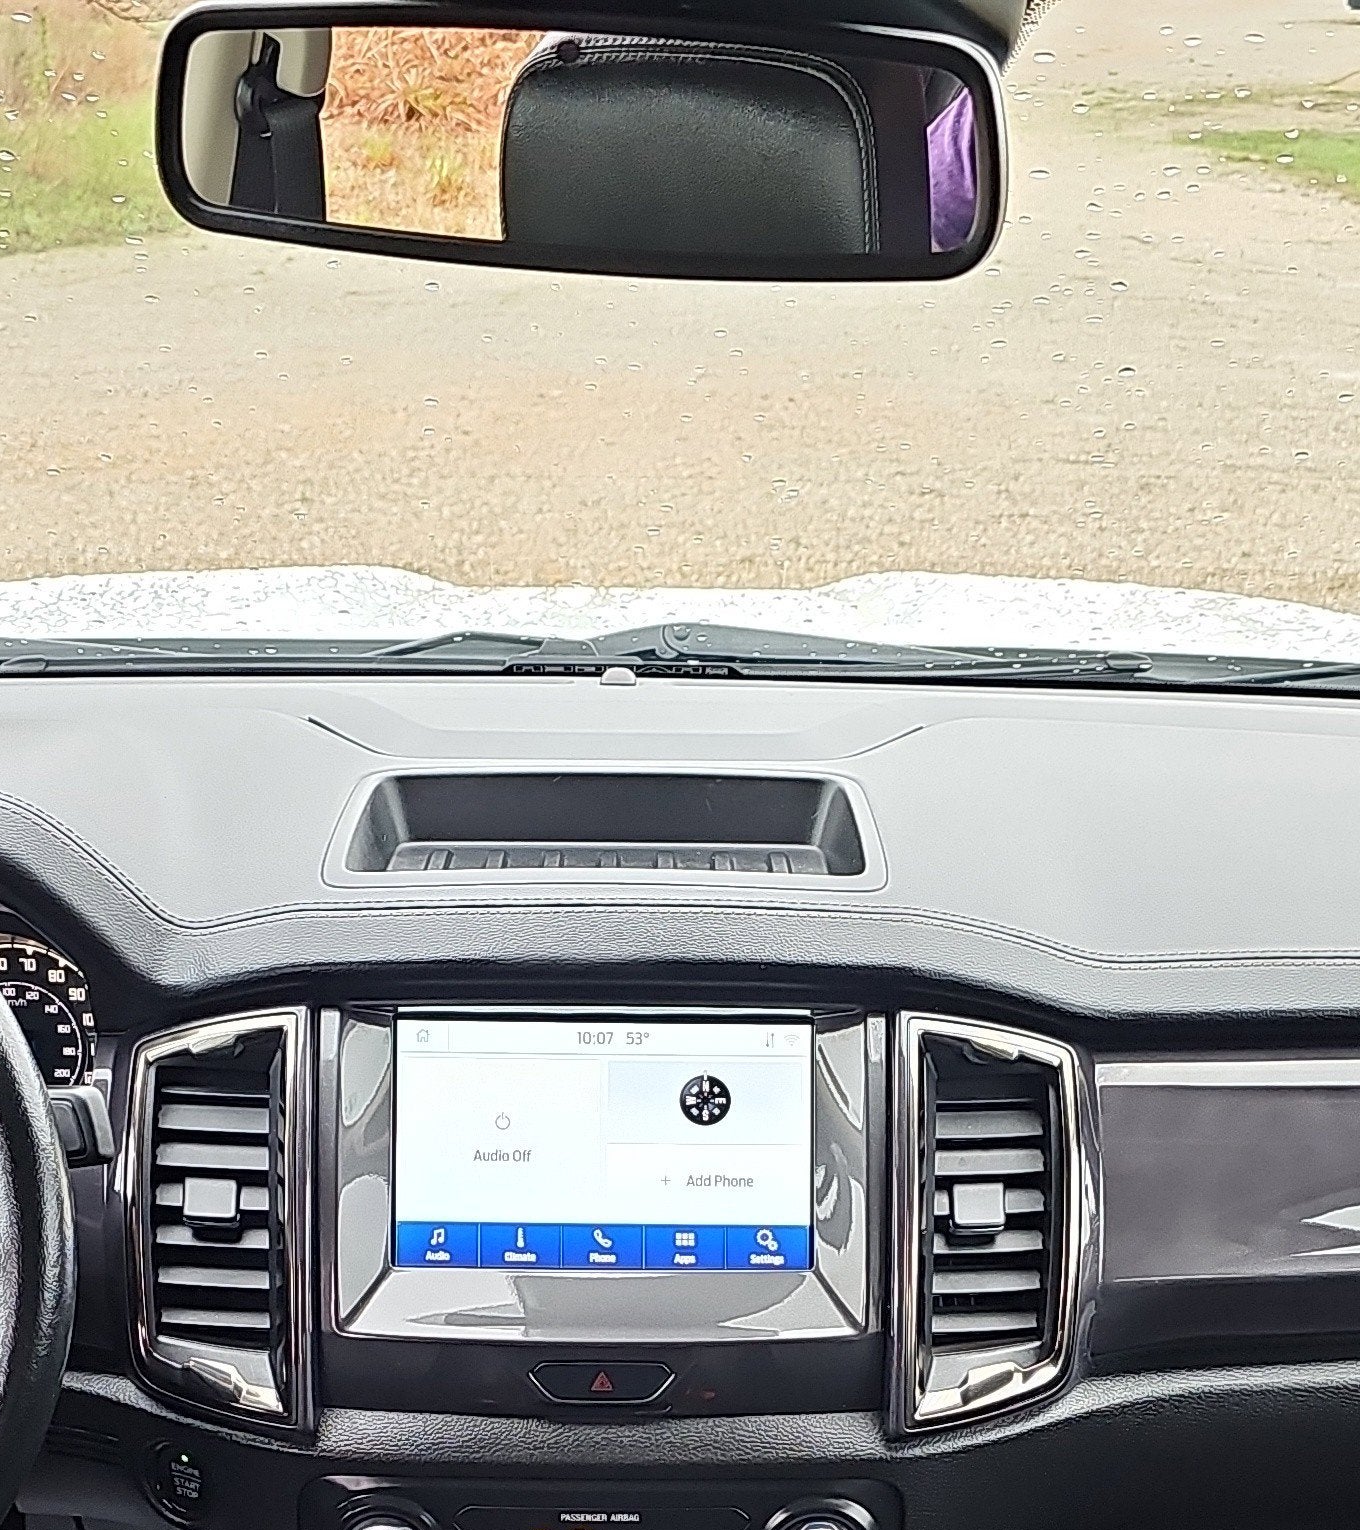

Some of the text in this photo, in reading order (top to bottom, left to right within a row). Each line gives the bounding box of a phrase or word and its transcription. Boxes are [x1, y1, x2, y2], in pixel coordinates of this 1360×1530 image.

[19, 957, 36, 972] 70
[48, 969, 65, 982] 80
[68, 987, 85, 1001] 90
[82, 1012, 95, 1027] 10
[577, 1031, 650, 1046] 10:07 53°
[473, 1149, 532, 1163] Audio Off
[686, 1174, 754, 1188] Add Phone
[426, 1250, 450, 1262] Audio
[504, 1251, 537, 1263] Climate
[589, 1252, 617, 1263] Phone
[674, 1253, 697, 1265] Apps
[750, 1253, 785, 1266] Settings
[171, 1462, 200, 1477] ENGINE
[174, 1478, 200, 1491] START
[176, 1487, 198, 1498] STOP
[560, 1513, 640, 1522] PASSENGER AIRBAG
